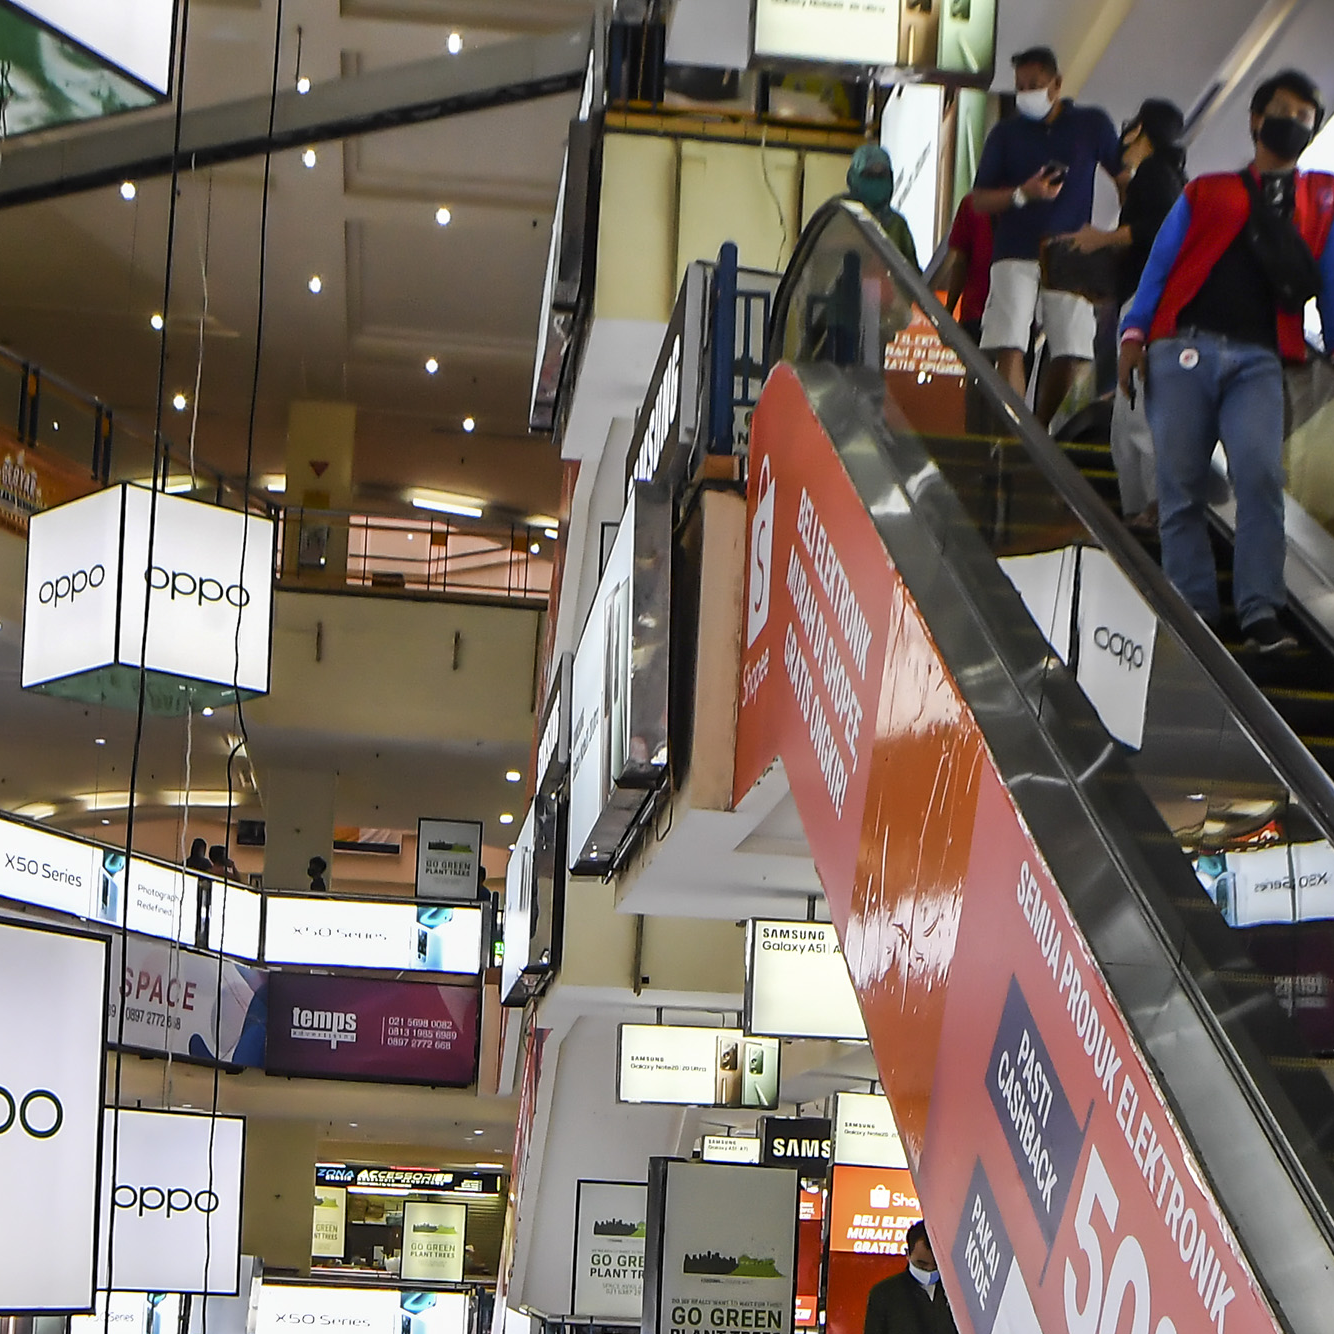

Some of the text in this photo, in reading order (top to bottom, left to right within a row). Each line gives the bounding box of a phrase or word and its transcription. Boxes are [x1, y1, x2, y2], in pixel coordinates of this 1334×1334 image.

[39, 564, 104, 608] oppo
[145, 566, 249, 607] oppo
[796, 487, 873, 682] BELI ELEKTRONIK
[742, 647, 770, 708] Shopee
[786, 544, 864, 776] MURAH DI SHOPEE,
[784, 621, 849, 821] GRATIS ONGKIR!
[4, 853, 82, 888] X50 Series
[762, 941, 806, 954] Galaxy
[808, 944, 826, 953] A51
[763, 928, 825, 941] SAMSUNG
[120, 966, 196, 1012] SPACE
[1016, 860, 1064, 981] SEMUA
[1059, 955, 1124, 1104] PRODUK
[290, 1006, 357, 1049] temps
[1016, 1028, 1055, 1129] PASTI
[996, 1049, 1060, 1213] CASHBACK
[317, 1168, 356, 1179] ZONA
[357, 1169, 454, 1184] ACCESSORIES
[113, 1185, 220, 1218] oppo
[853, 1214, 880, 1227] BELI
[846, 1227, 892, 1242] MURAH
[971, 1193, 1002, 1282] PAKAI
[590, 1268, 626, 1279] PLANT
[591, 1254, 612, 1266] GO
[965, 1231, 991, 1312] KODE
[275, 1313, 316, 1326] X50
[671, 1306, 783, 1330] GO GREEN
